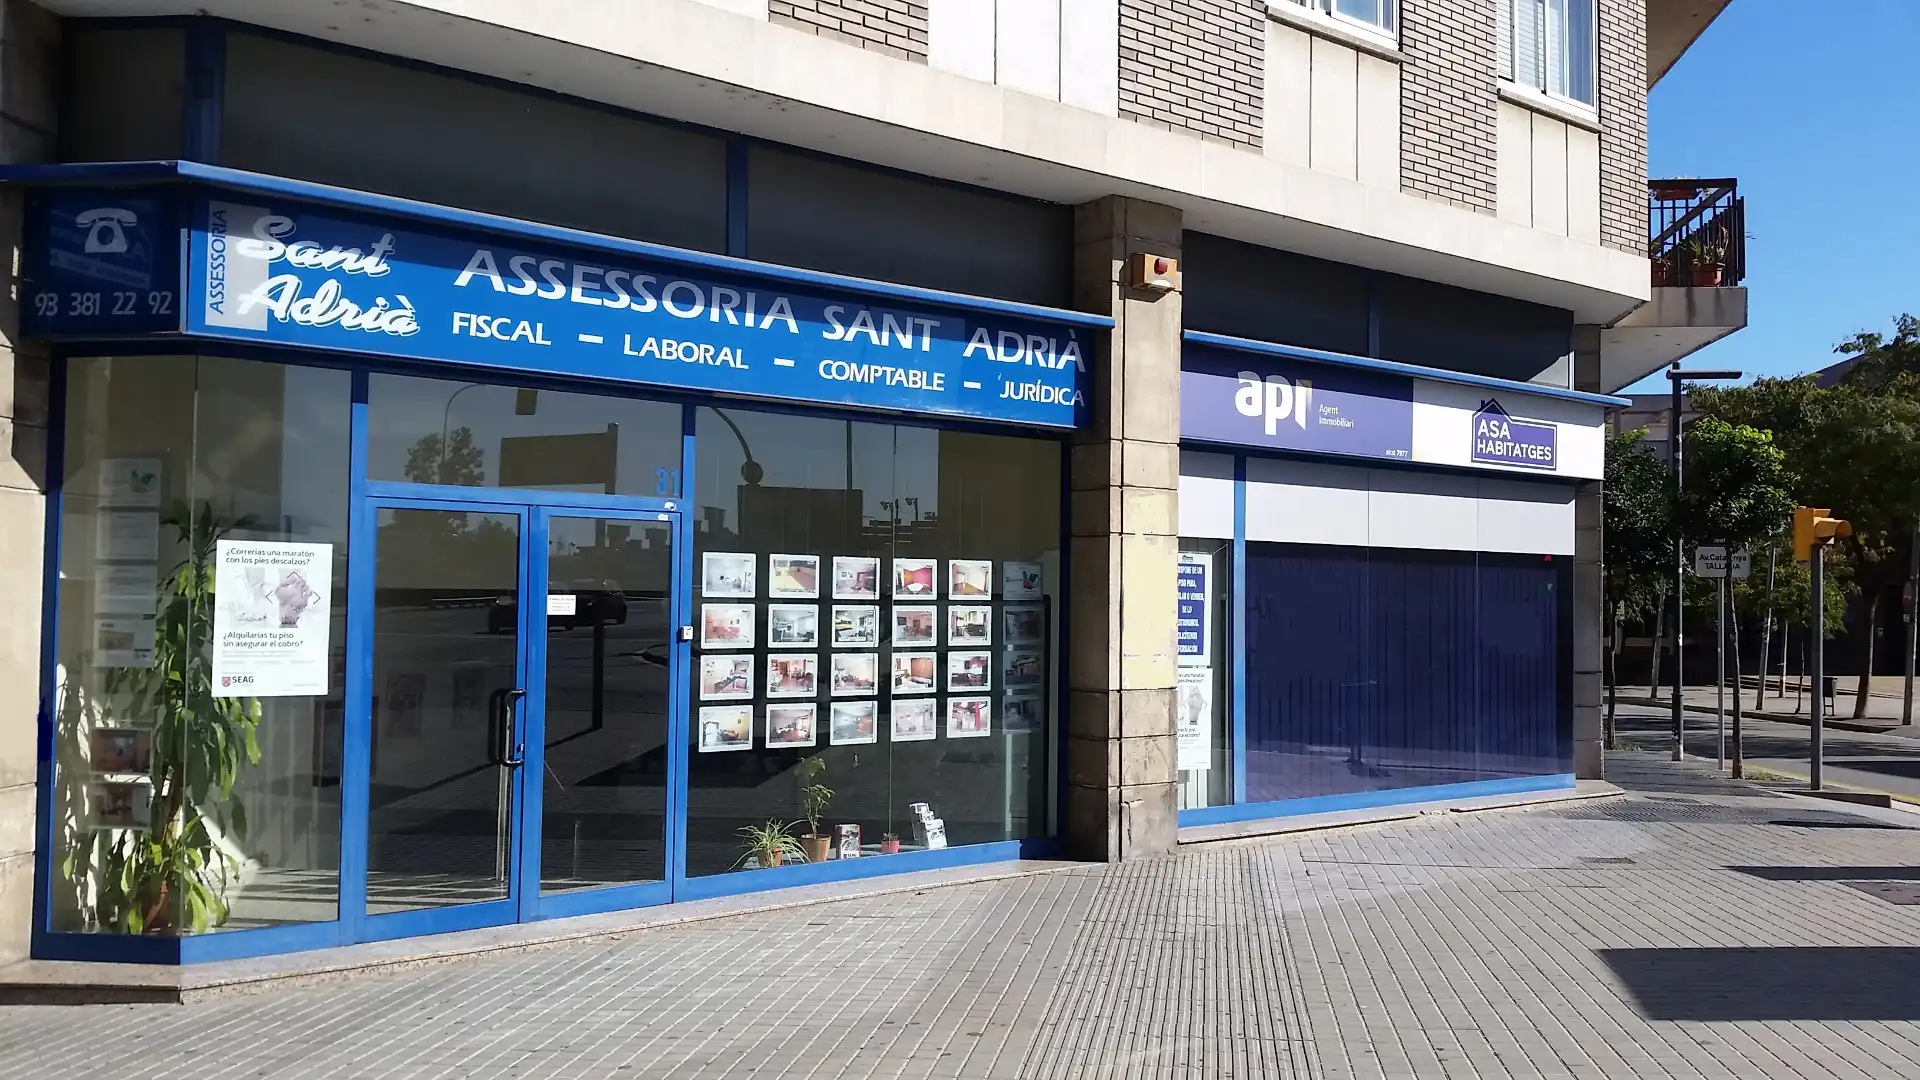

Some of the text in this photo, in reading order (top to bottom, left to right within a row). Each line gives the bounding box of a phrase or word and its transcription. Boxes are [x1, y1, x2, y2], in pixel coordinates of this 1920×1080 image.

[237, 215, 396, 276] Sant
[209, 208, 228, 315] ASSESSORIA
[35, 288, 172, 317] 93 381 22 92
[237, 274, 421, 337] Adrià
[454, 249, 1086, 373] ASSESSORIA SANT ADRIÀ
[452, 312, 552, 345] FISCAL
[624, 334, 749, 369] LABORAL
[819, 359, 946, 391] COMPTABLE
[1000, 379, 1085, 407] JURÍDICA
[1318, 404, 1339, 415] Agent
[1477, 419, 1511, 439] ASA
[1477, 439, 1552, 461] HABITATGES
[654, 467, 680, 496] 31
[241, 556, 253, 564] los
[254, 557, 270, 565] pies
[270, 557, 310, 566] descalzos?
[236, 641, 268, 649] asegurar
[278, 632, 295, 640] piso
[232, 676, 254, 684] SEAG
